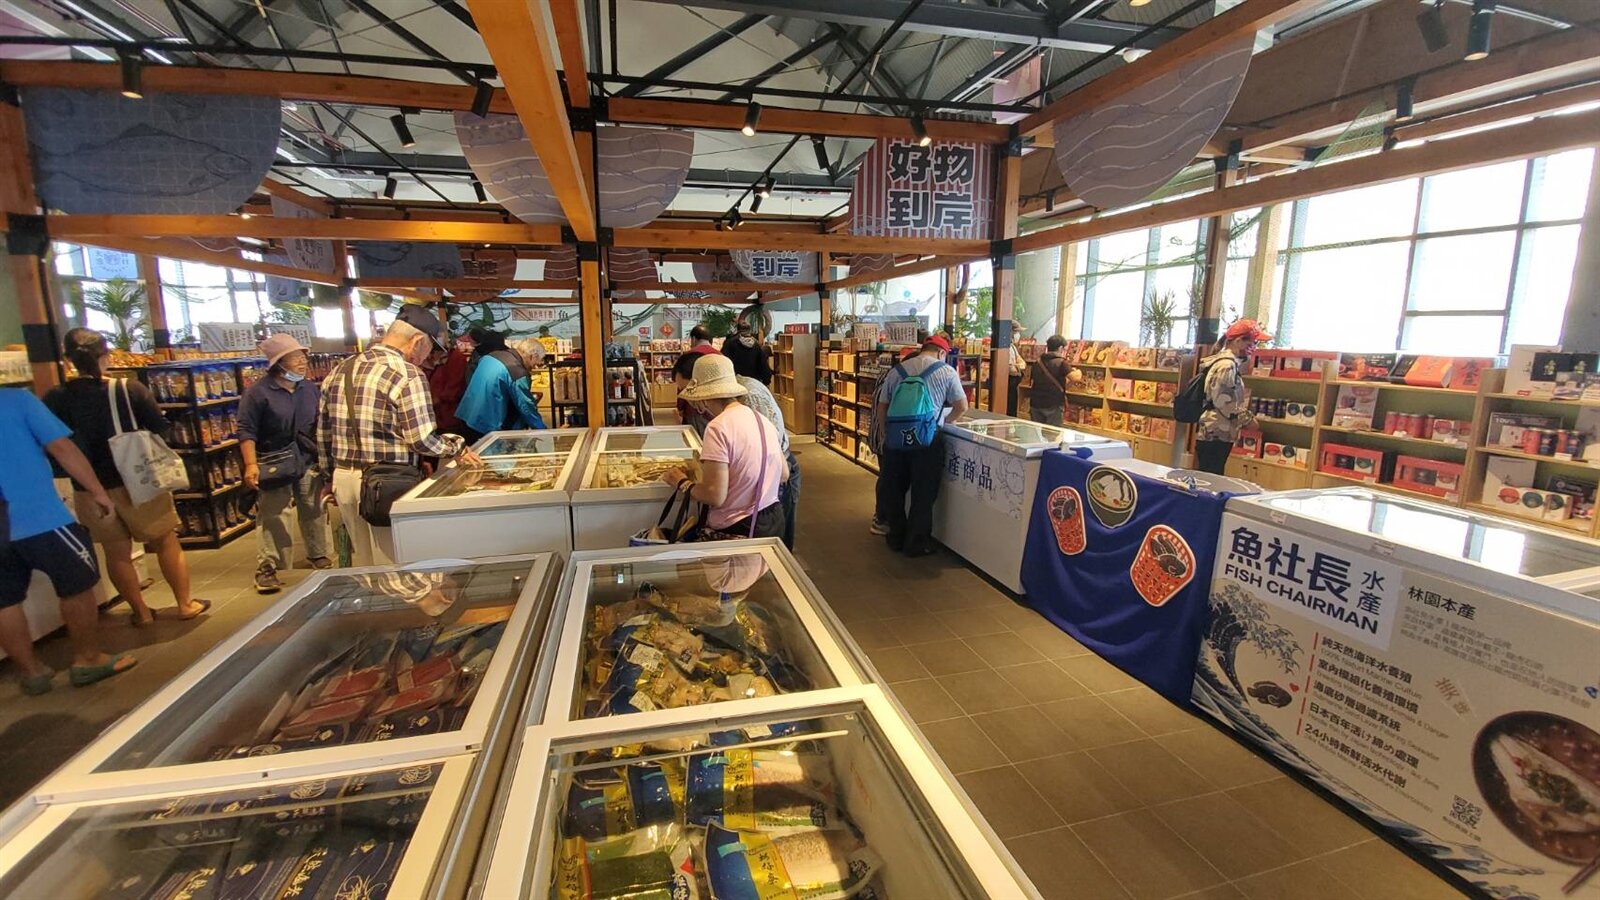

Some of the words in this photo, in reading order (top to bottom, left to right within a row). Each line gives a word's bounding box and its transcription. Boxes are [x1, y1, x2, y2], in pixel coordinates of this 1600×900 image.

[888, 140, 976, 186] 好物
[888, 189, 974, 230] 到岸
[752, 257, 799, 277] 到岸
[1227, 526, 1352, 603] 魚社長
[1224, 563, 1263, 588] FISH
[1266, 580, 1379, 635] CHAIRMAN
[1356, 570, 1386, 616] 水產
[1407, 585, 1477, 621] 林園本產
